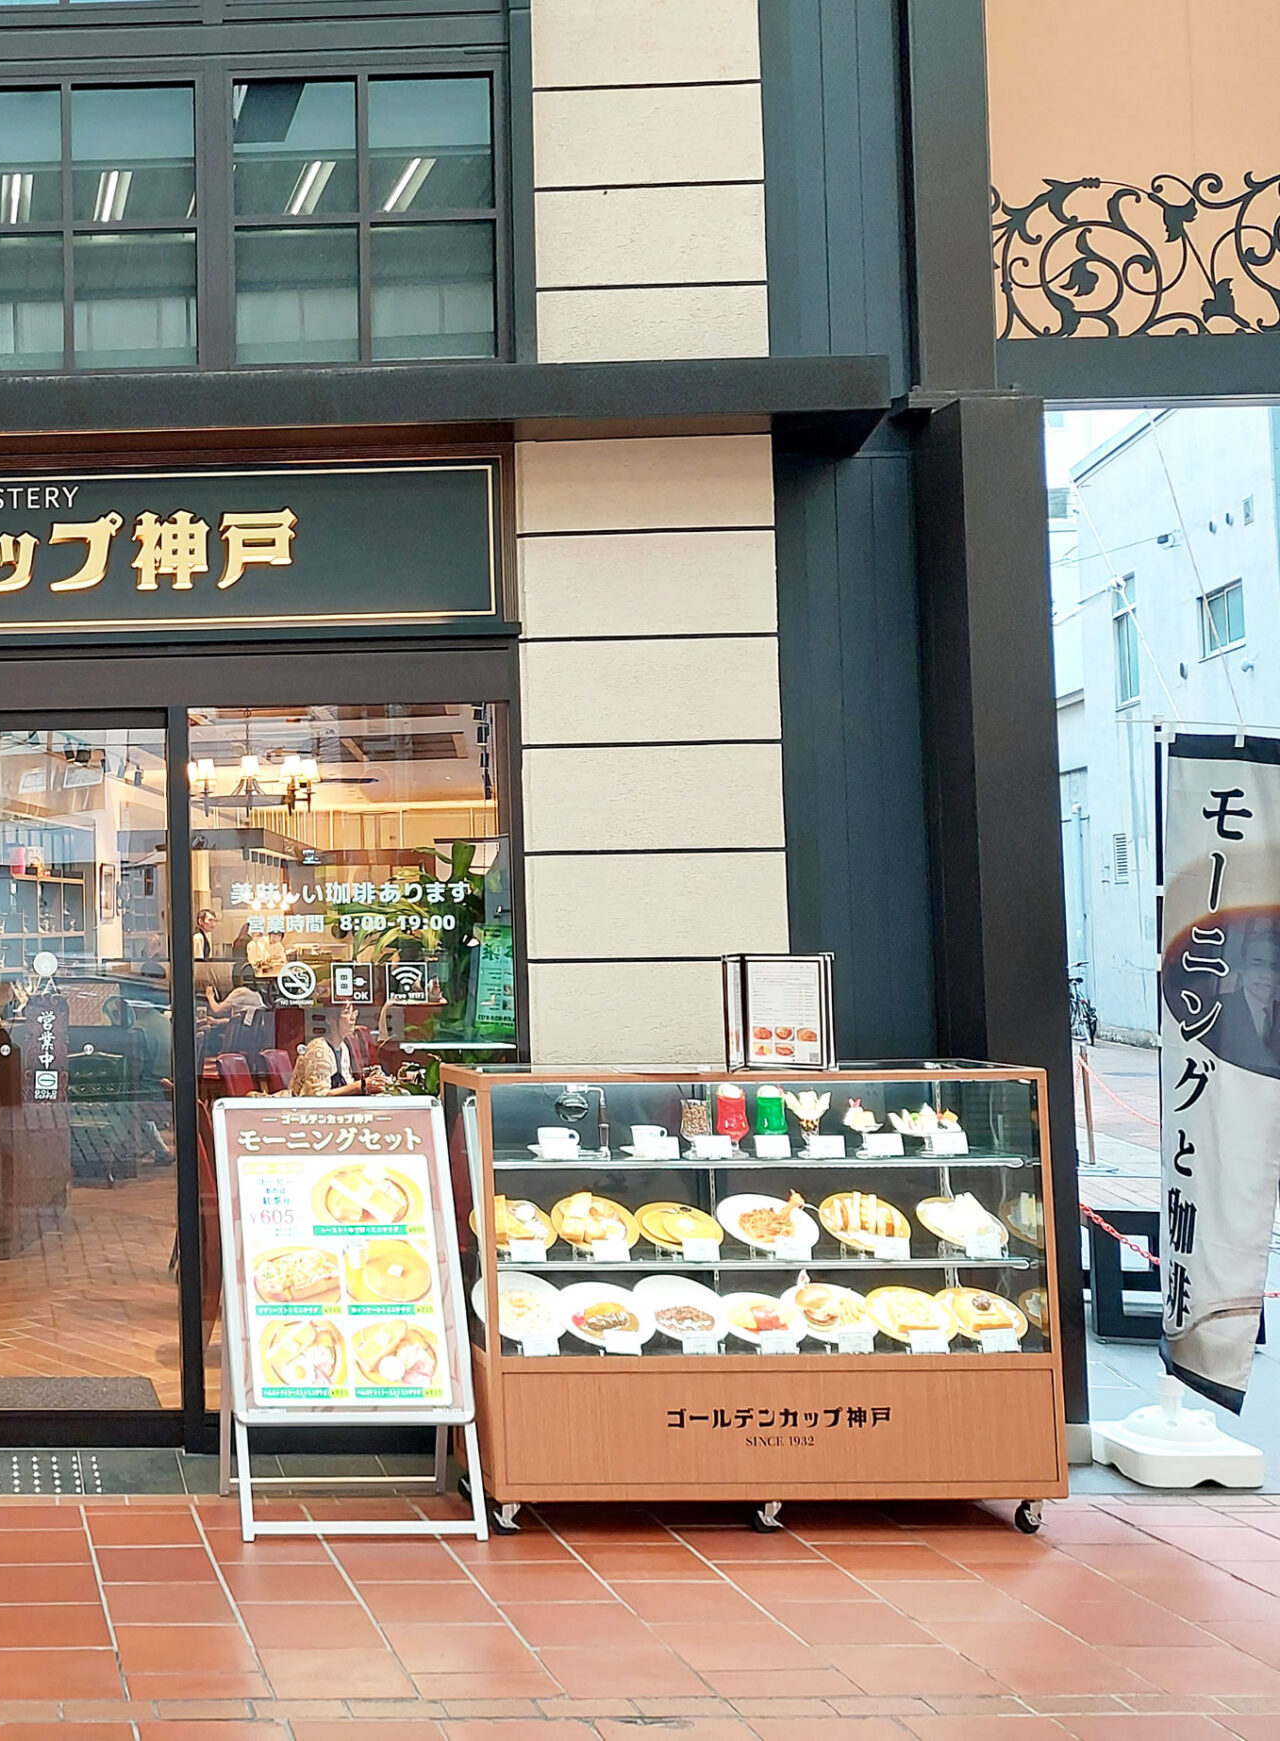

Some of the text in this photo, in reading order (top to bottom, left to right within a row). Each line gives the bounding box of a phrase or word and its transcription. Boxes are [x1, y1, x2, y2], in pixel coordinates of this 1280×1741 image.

[230, 880, 470, 906] 美味しい珈琲あります
[248, 913, 456, 935] 営業時間 8:00-19:00
[353, 991, 369, 1001] OK
[37, 1010, 56, 1070] 営業中
[1166, 787, 1254, 1328] モーニングと珈琲
[237, 1127, 422, 1152] モーニングセット
[667, 1407, 891, 1429] ゴールデンカップ神戸
[746, 1435, 815, 1447] SINCE 1932
